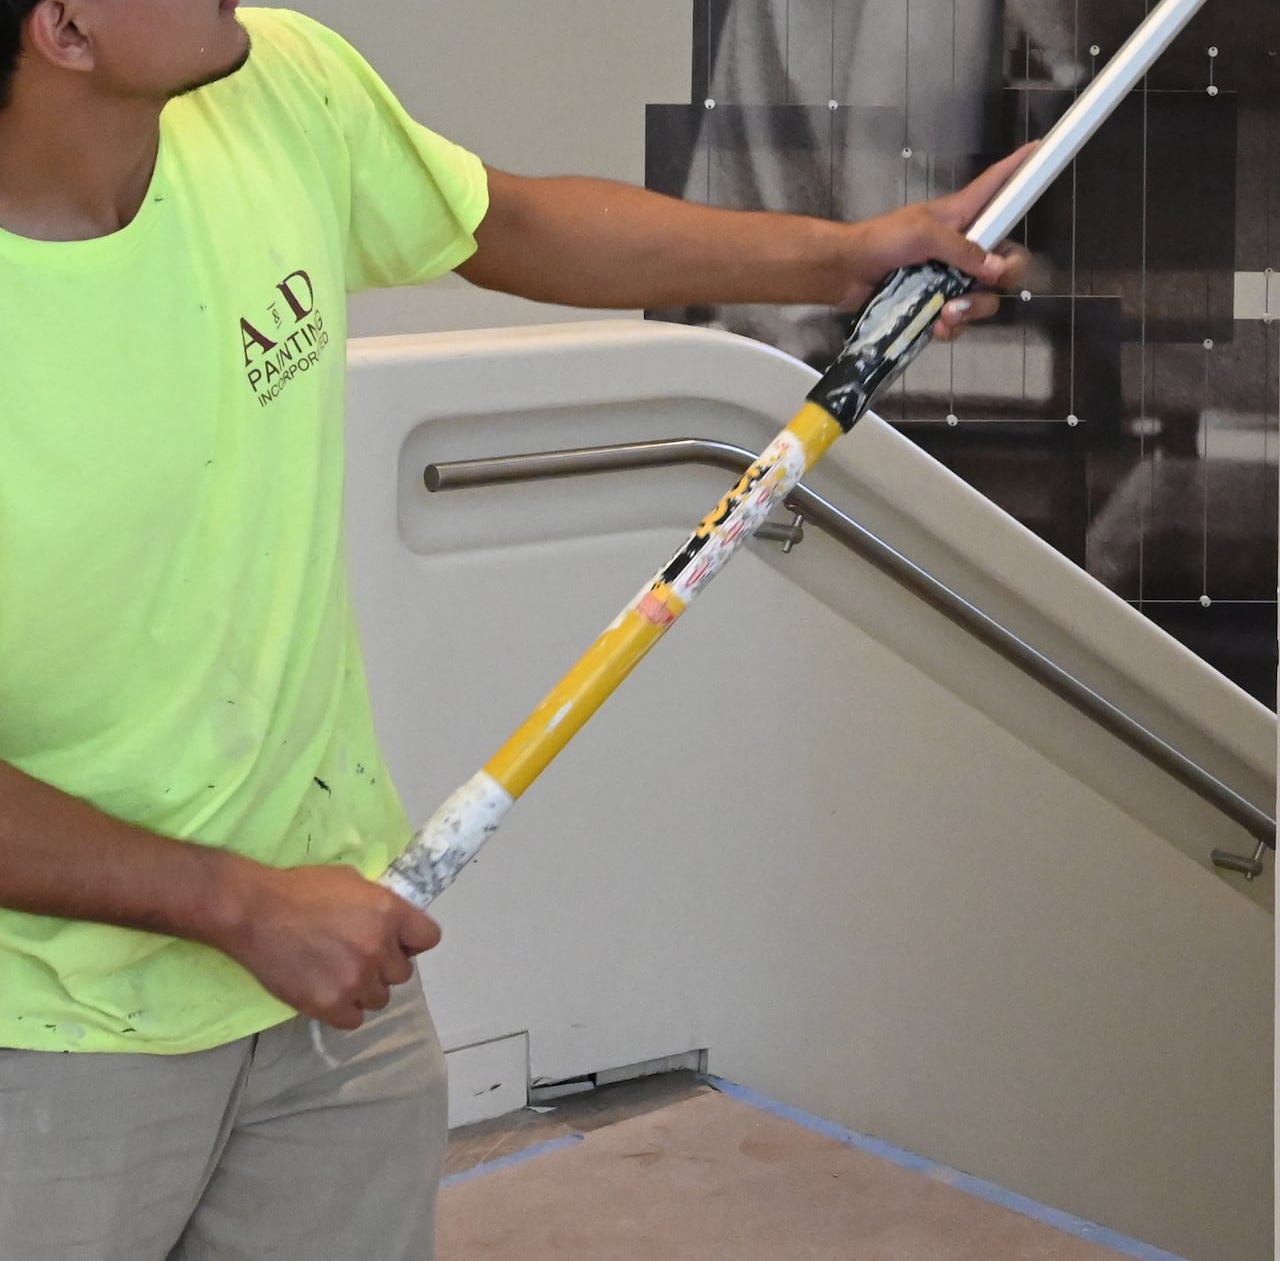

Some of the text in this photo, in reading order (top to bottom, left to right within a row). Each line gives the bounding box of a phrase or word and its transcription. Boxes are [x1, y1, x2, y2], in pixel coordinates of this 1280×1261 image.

[239, 316, 278, 368] A
[275, 269, 314, 324] D
[257, 331, 329, 408] INCORPORED
